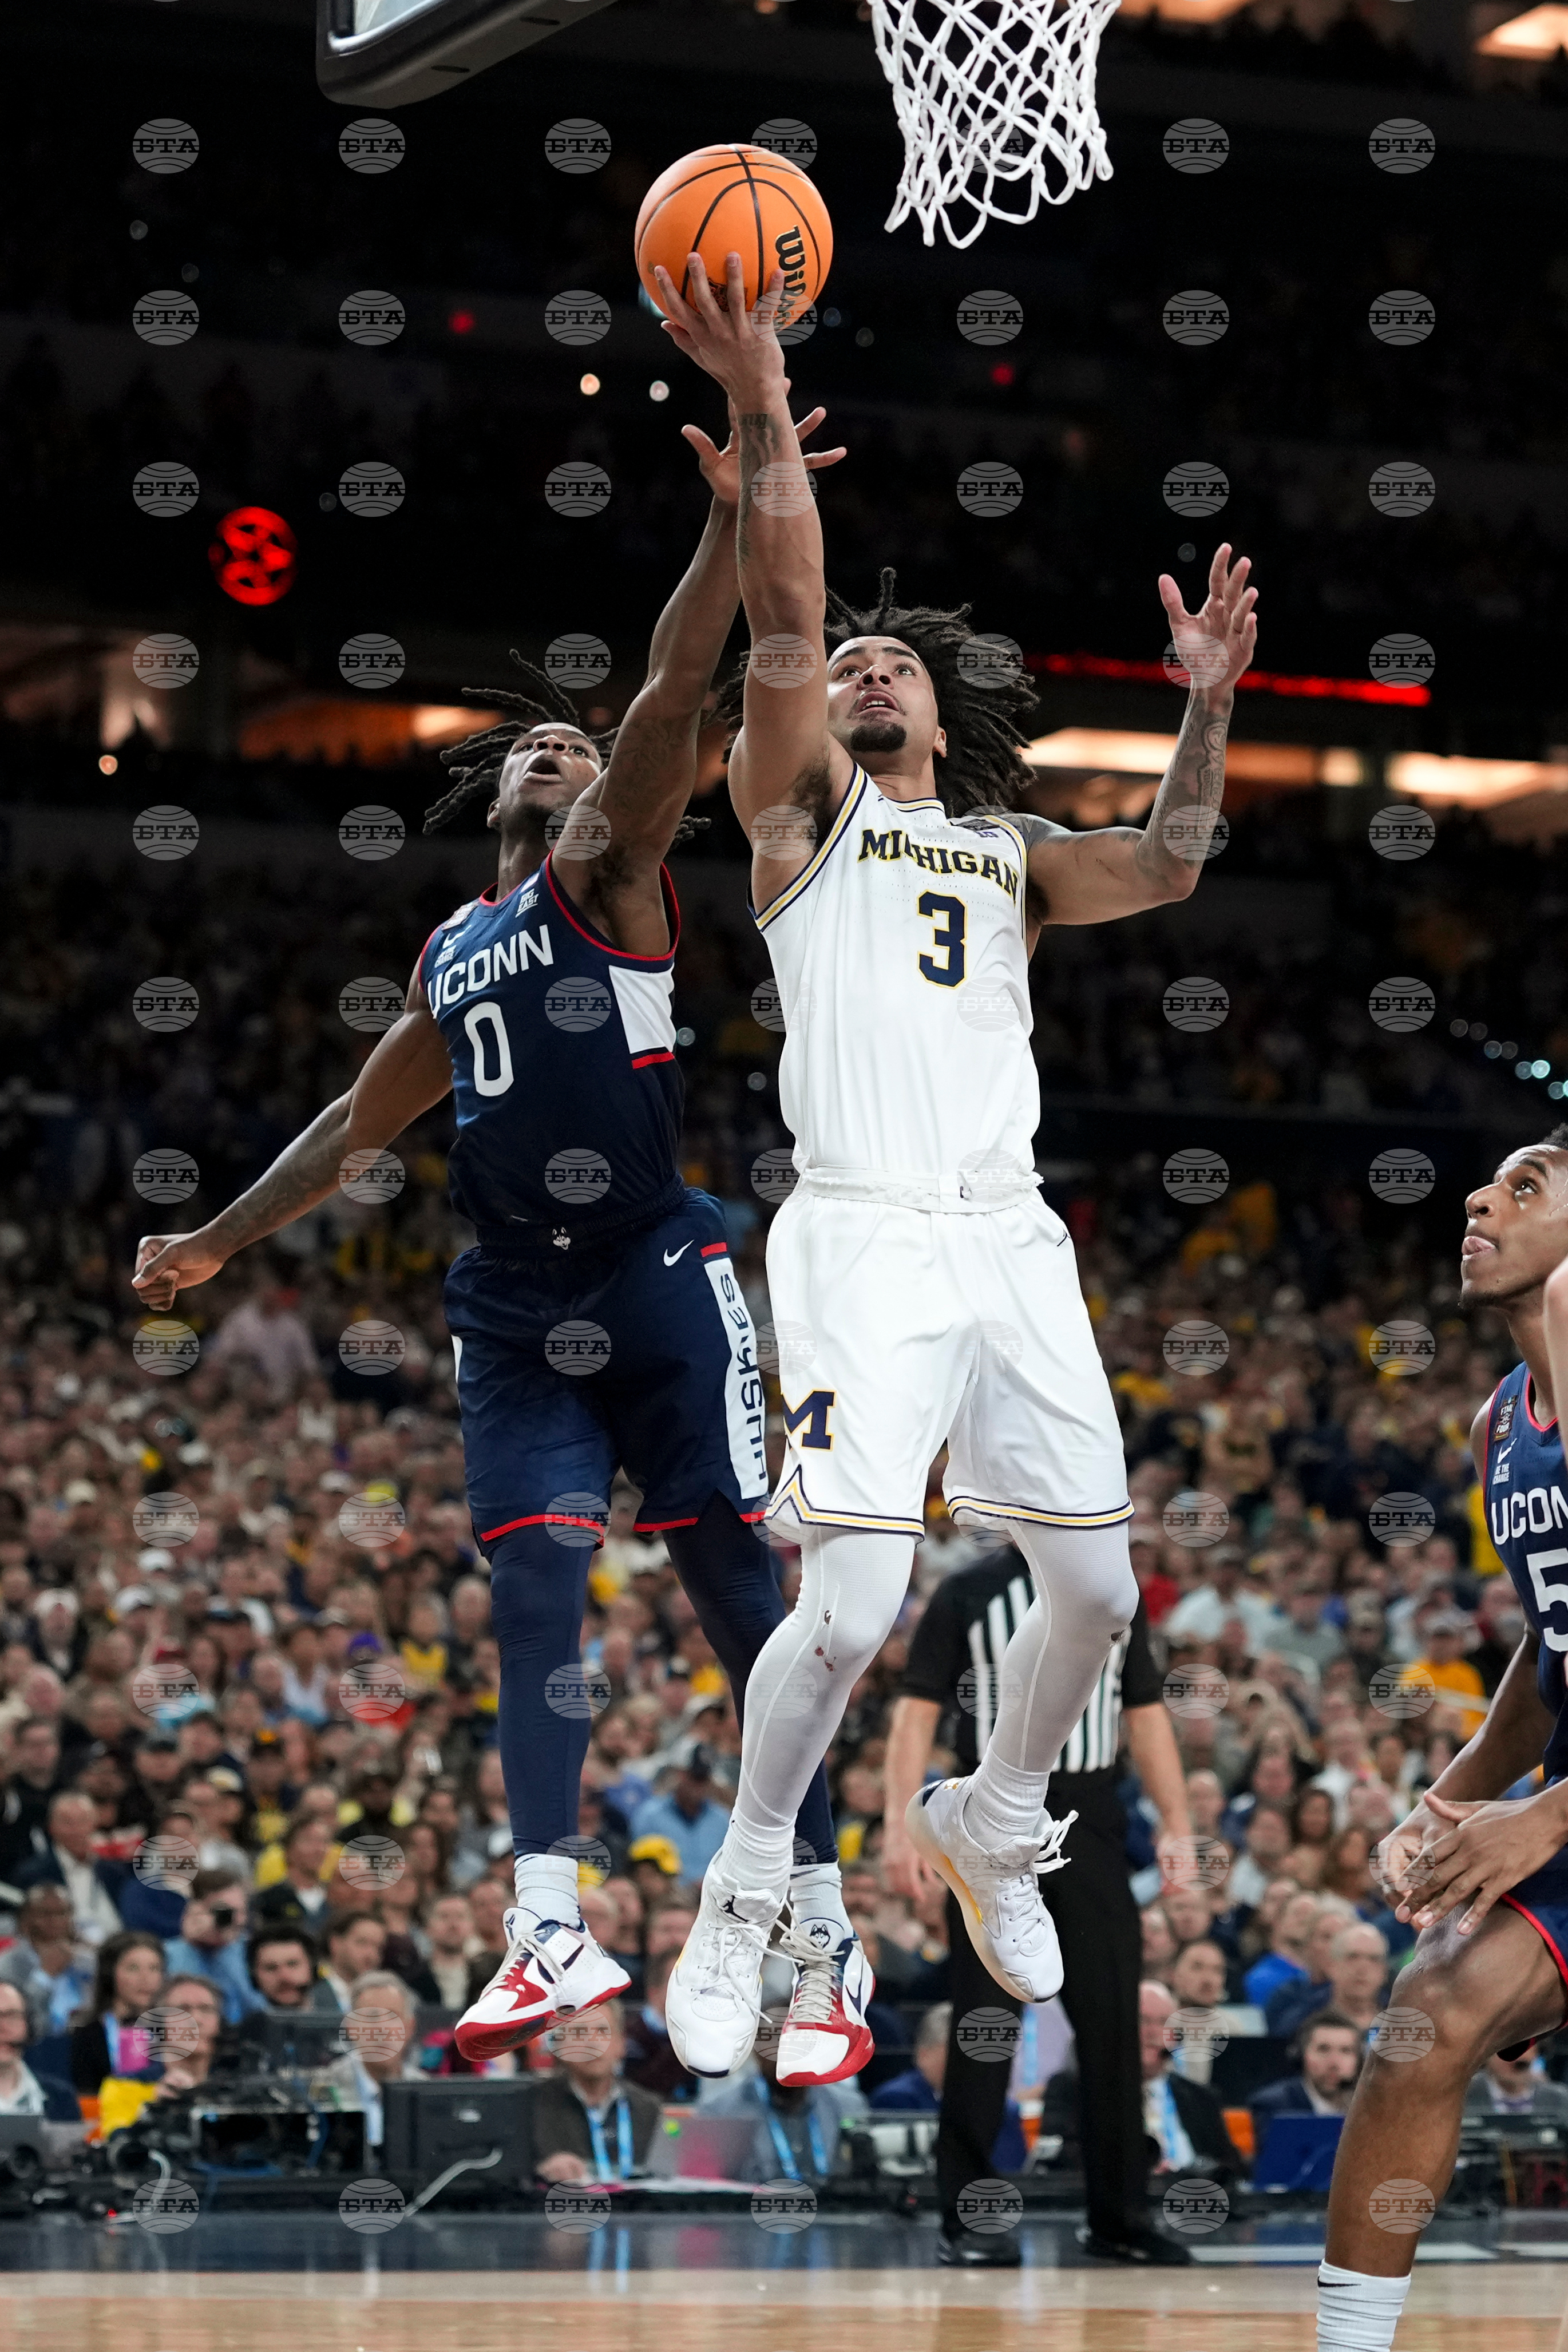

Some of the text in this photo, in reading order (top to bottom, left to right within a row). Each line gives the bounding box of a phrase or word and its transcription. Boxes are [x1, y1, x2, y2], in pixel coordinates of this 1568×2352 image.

[517, 893, 539, 913] EAST
[520, 888, 535, 904] BIG
[917, 889, 967, 989] 3
[427, 924, 553, 1019] UCONN
[464, 1001, 514, 1096] 0
[782, 1389, 837, 1451] M
[1526, 1547, 1568, 1652] 5
